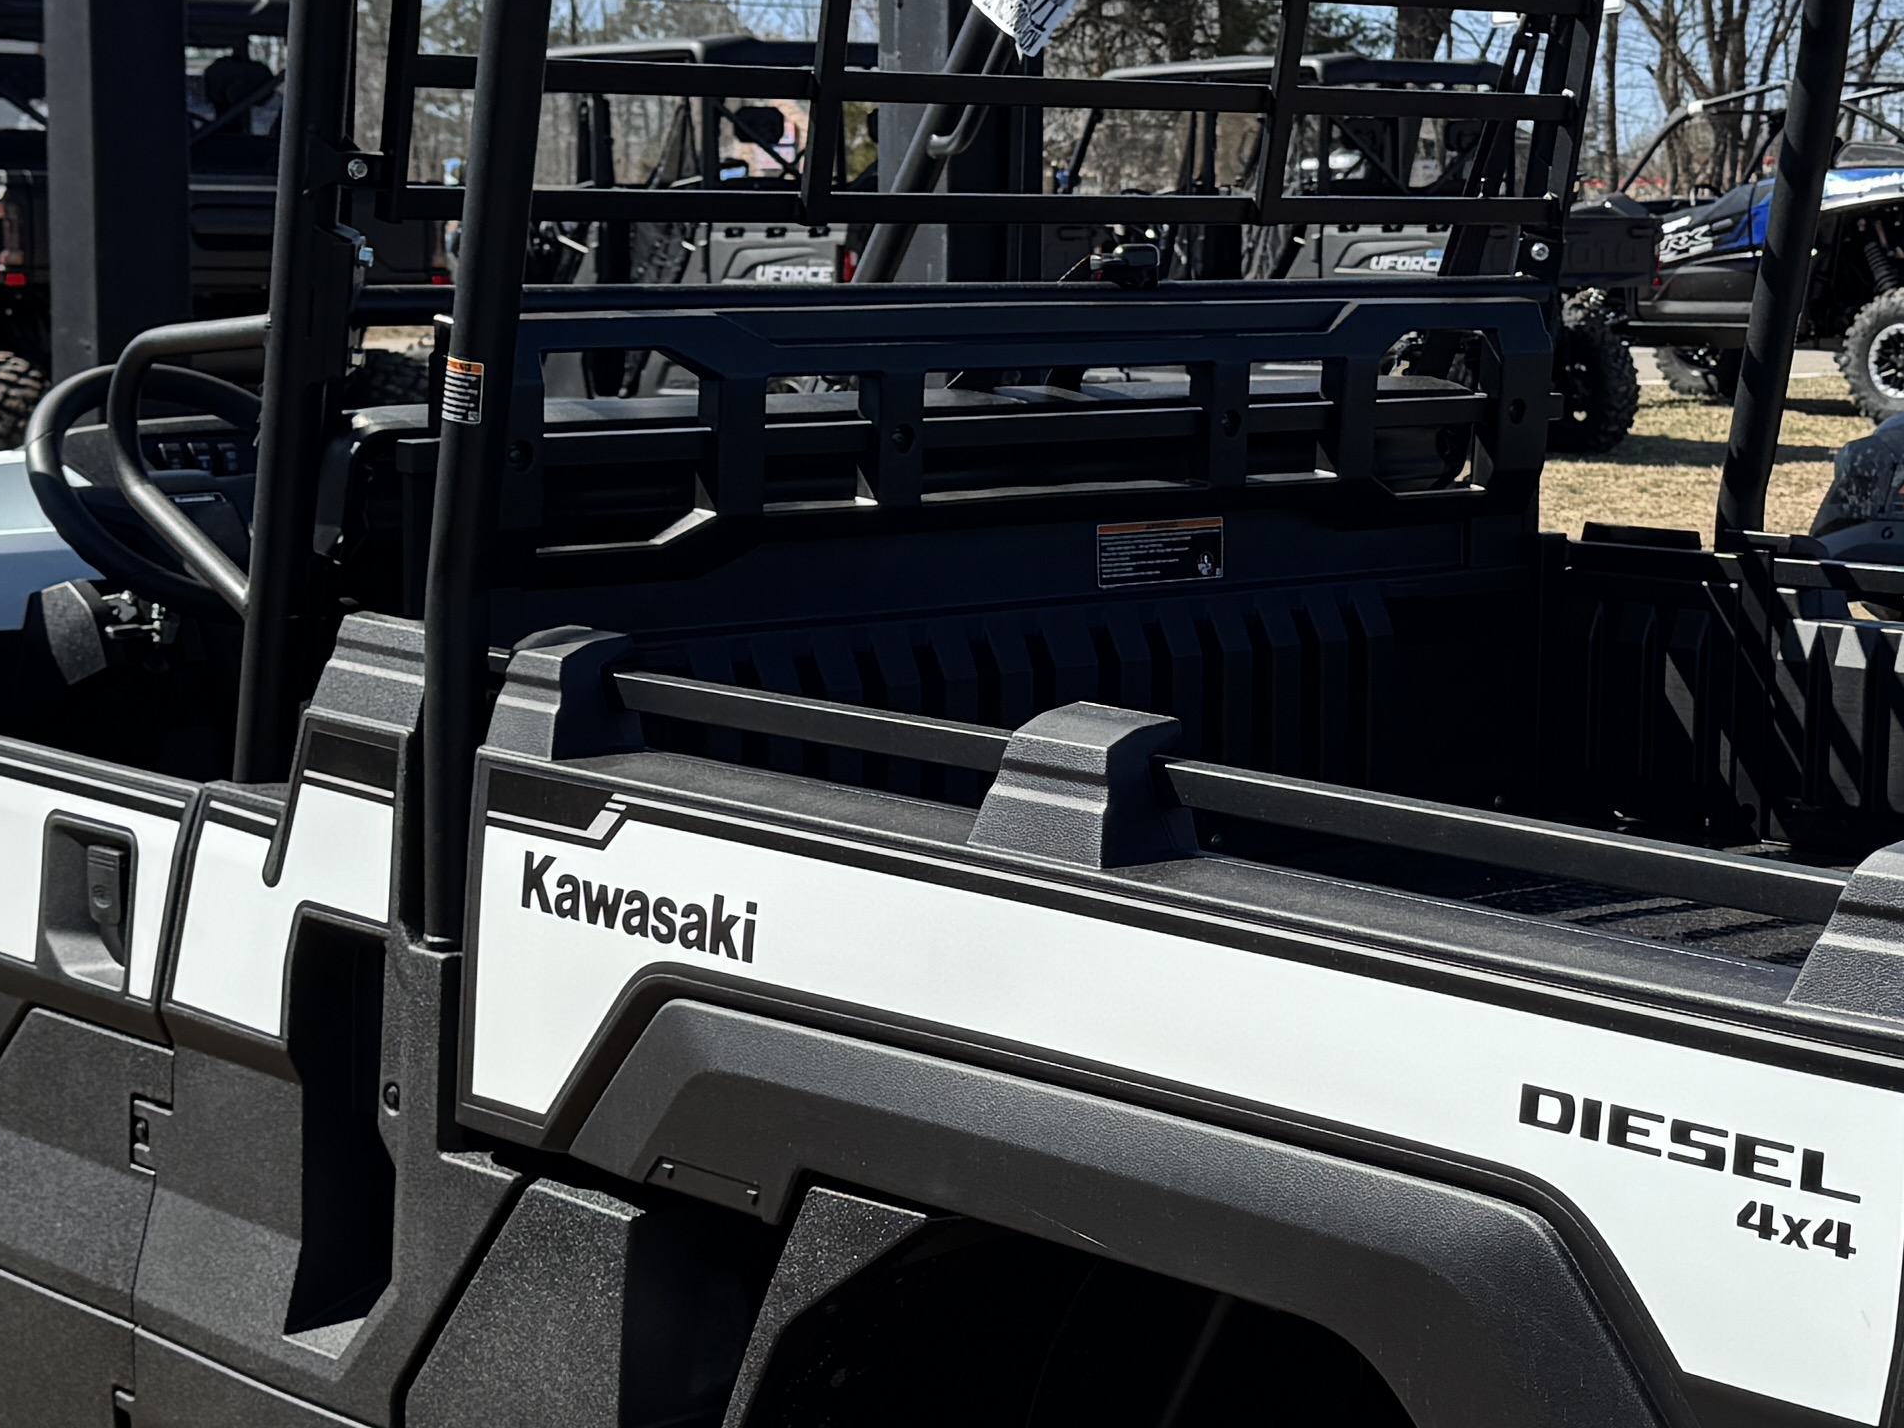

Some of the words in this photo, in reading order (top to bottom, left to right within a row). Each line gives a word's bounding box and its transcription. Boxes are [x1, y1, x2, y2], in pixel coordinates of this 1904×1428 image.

[755, 264, 834, 283] UFORCE
[521, 850, 758, 964] Kawasaki
[1519, 1082, 1861, 1204] DIESEL
[1736, 1200, 1857, 1260] 4x4
